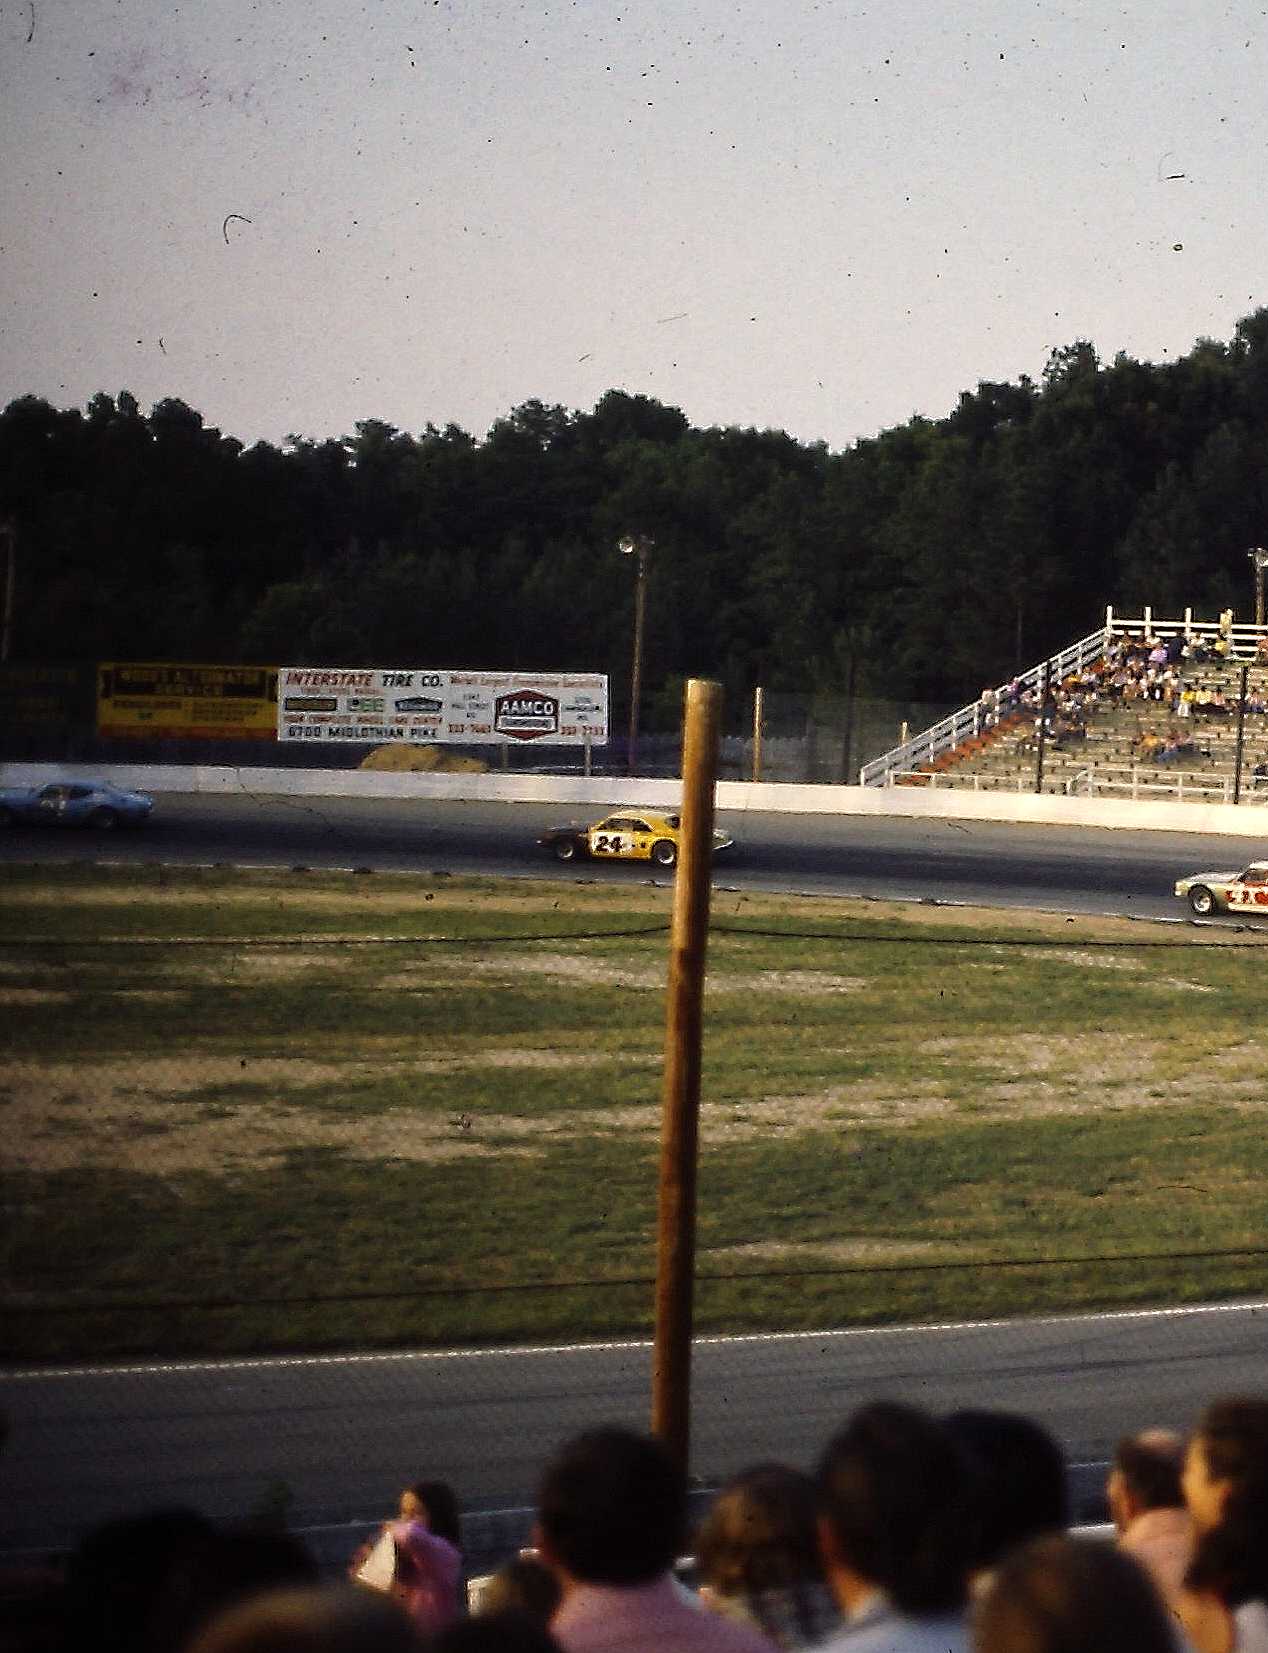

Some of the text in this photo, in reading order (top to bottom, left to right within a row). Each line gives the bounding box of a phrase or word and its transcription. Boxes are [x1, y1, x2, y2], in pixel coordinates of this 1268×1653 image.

[287, 672, 373, 686] INTERSTATE
[382, 674, 414, 687] TIRE
[422, 674, 444, 687] CO.
[500, 700, 554, 715] AAMCO
[288, 726, 321, 738] 6700
[328, 727, 404, 738] MIDLOTHIAN
[410, 727, 438, 738] PIKE
[597, 835, 622, 853] 24
